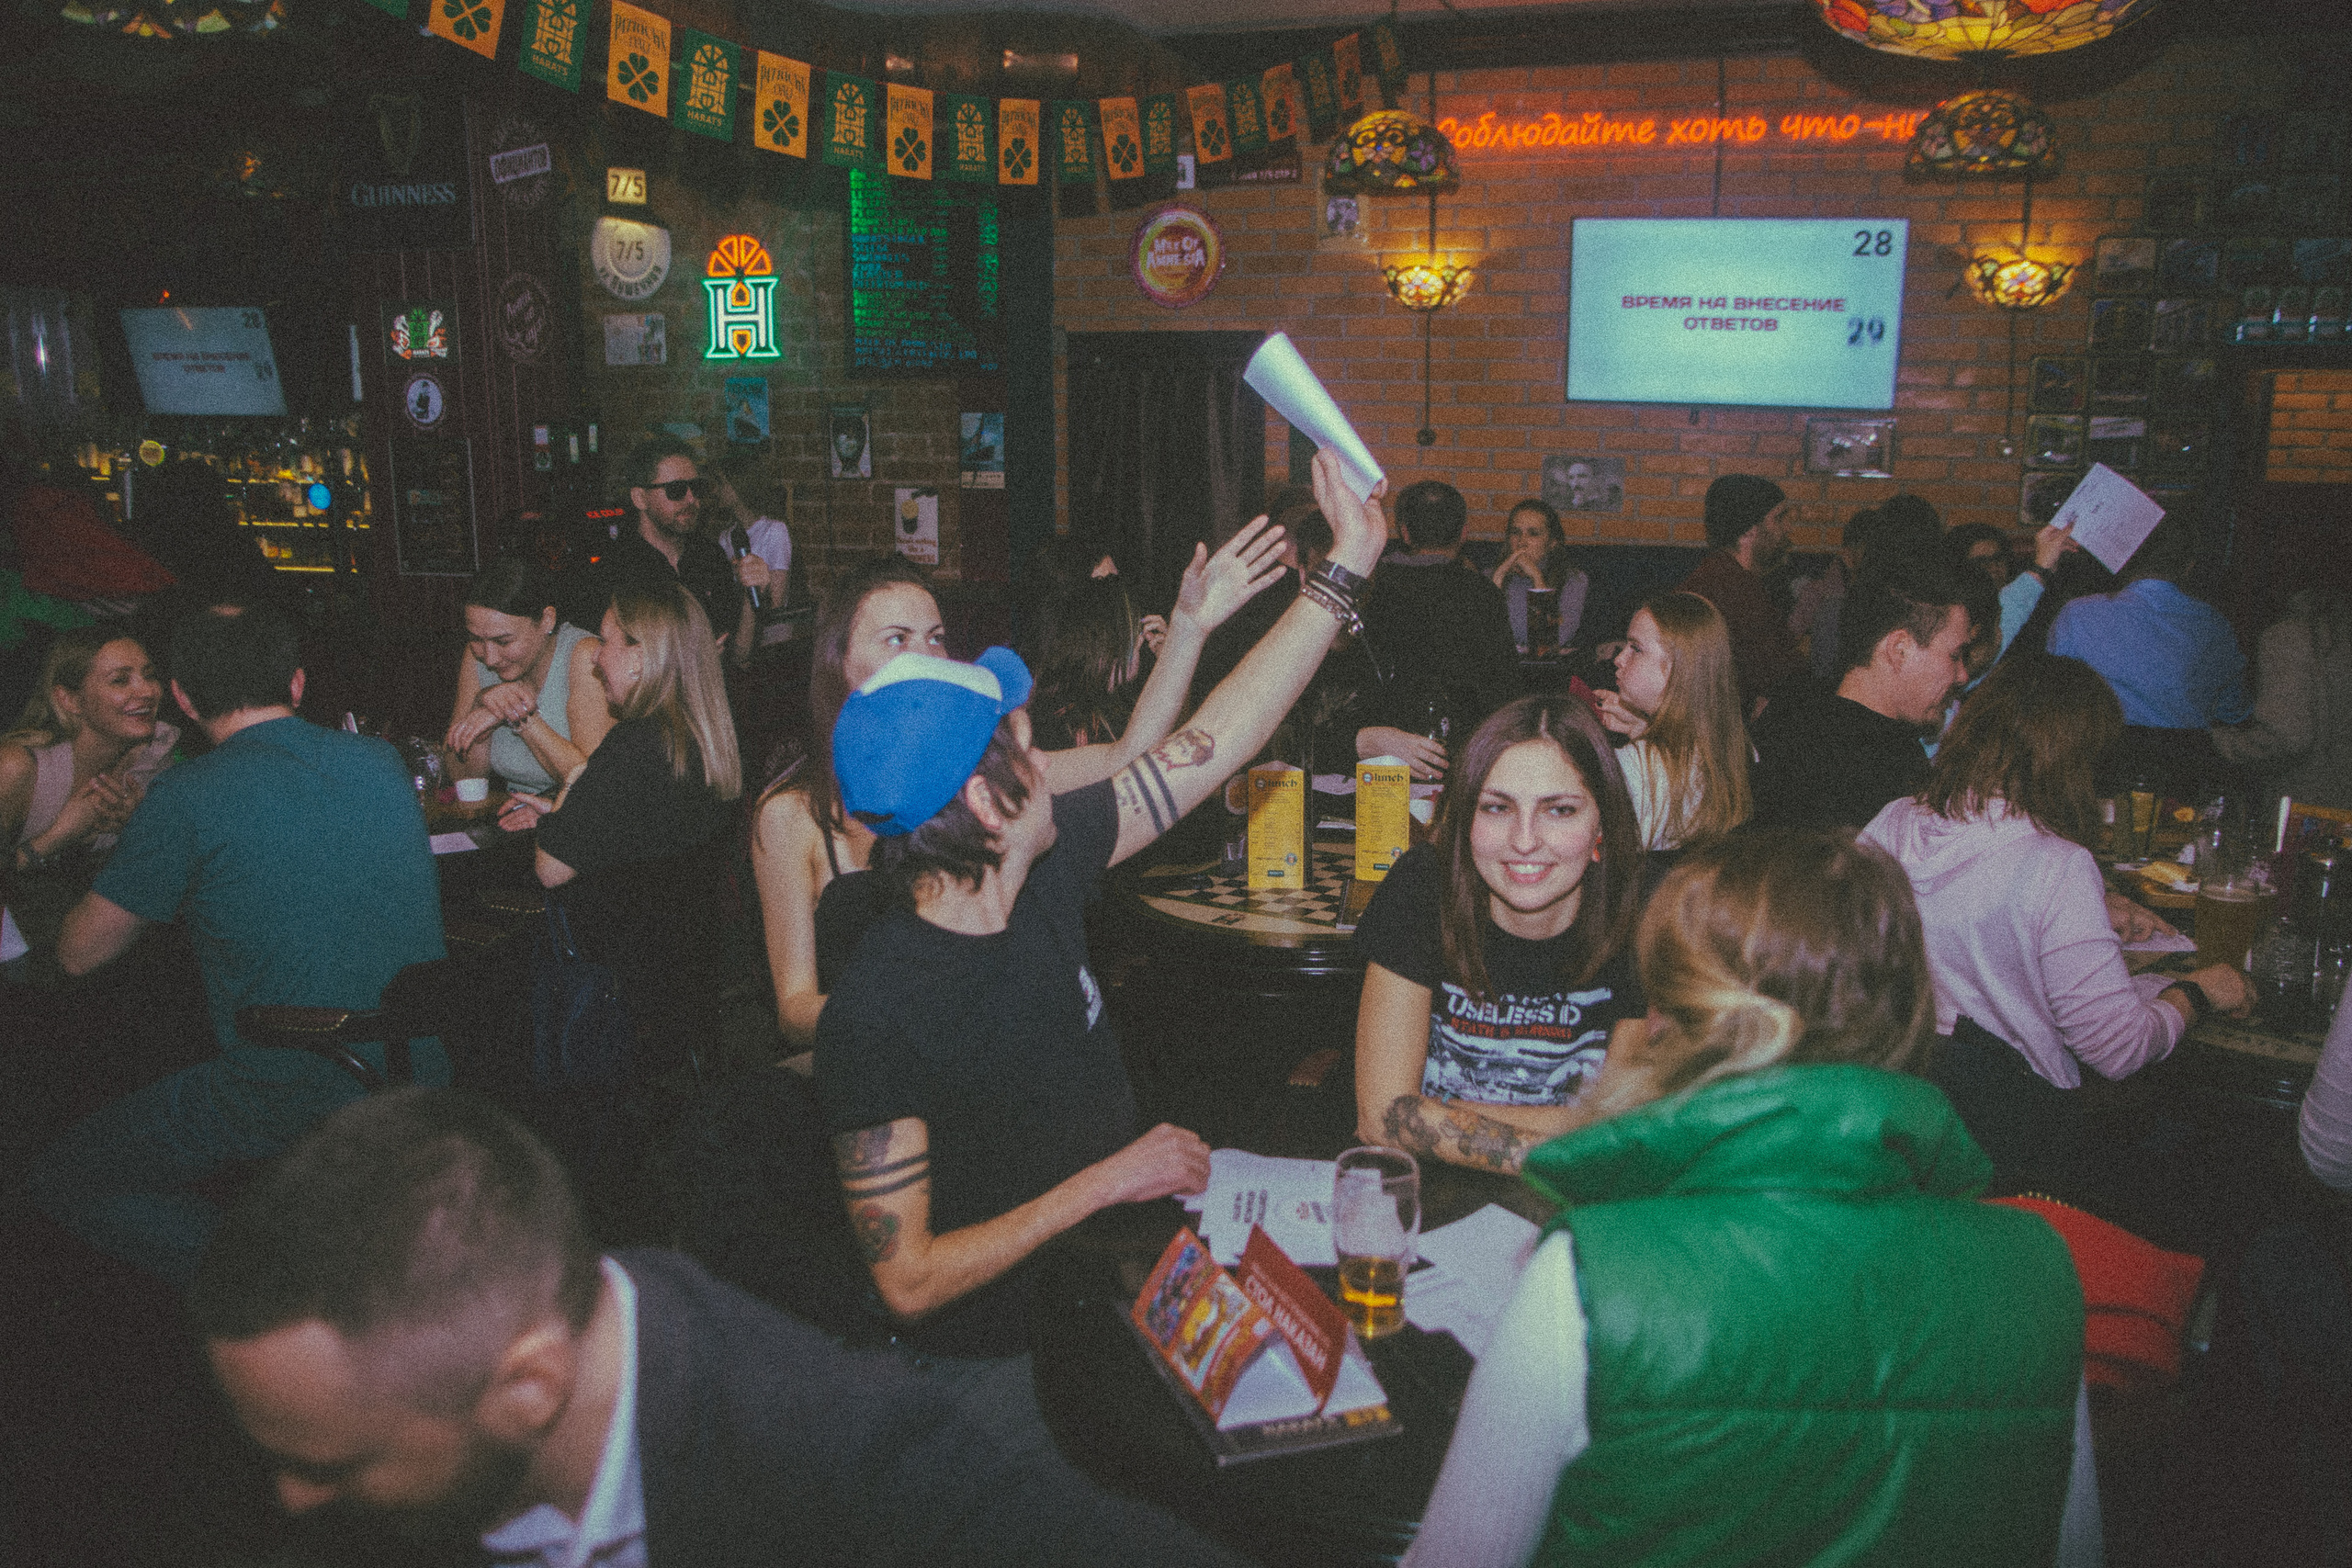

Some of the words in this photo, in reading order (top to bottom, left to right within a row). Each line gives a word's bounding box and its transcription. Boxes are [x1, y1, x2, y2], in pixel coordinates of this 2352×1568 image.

[1667, 117, 1769, 145] хоть
[1780, 111, 1929, 143] что-ни
[351, 181, 457, 208] GUINNESS
[611, 174, 643, 197] 7/5
[616, 241, 644, 261] 7/5
[1852, 230, 1893, 257] 28
[1622, 295, 1691, 310] ВРЕМЯ
[1699, 296, 1727, 310] НА
[1733, 297, 1846, 312] ВНЕСЕНИЕ
[1683, 316, 1778, 332] ОТВЕТОВ
[1267, 778, 1297, 787] lunch
[1374, 773, 1404, 783] lunch
[1448, 993, 1555, 1025] USELESS
